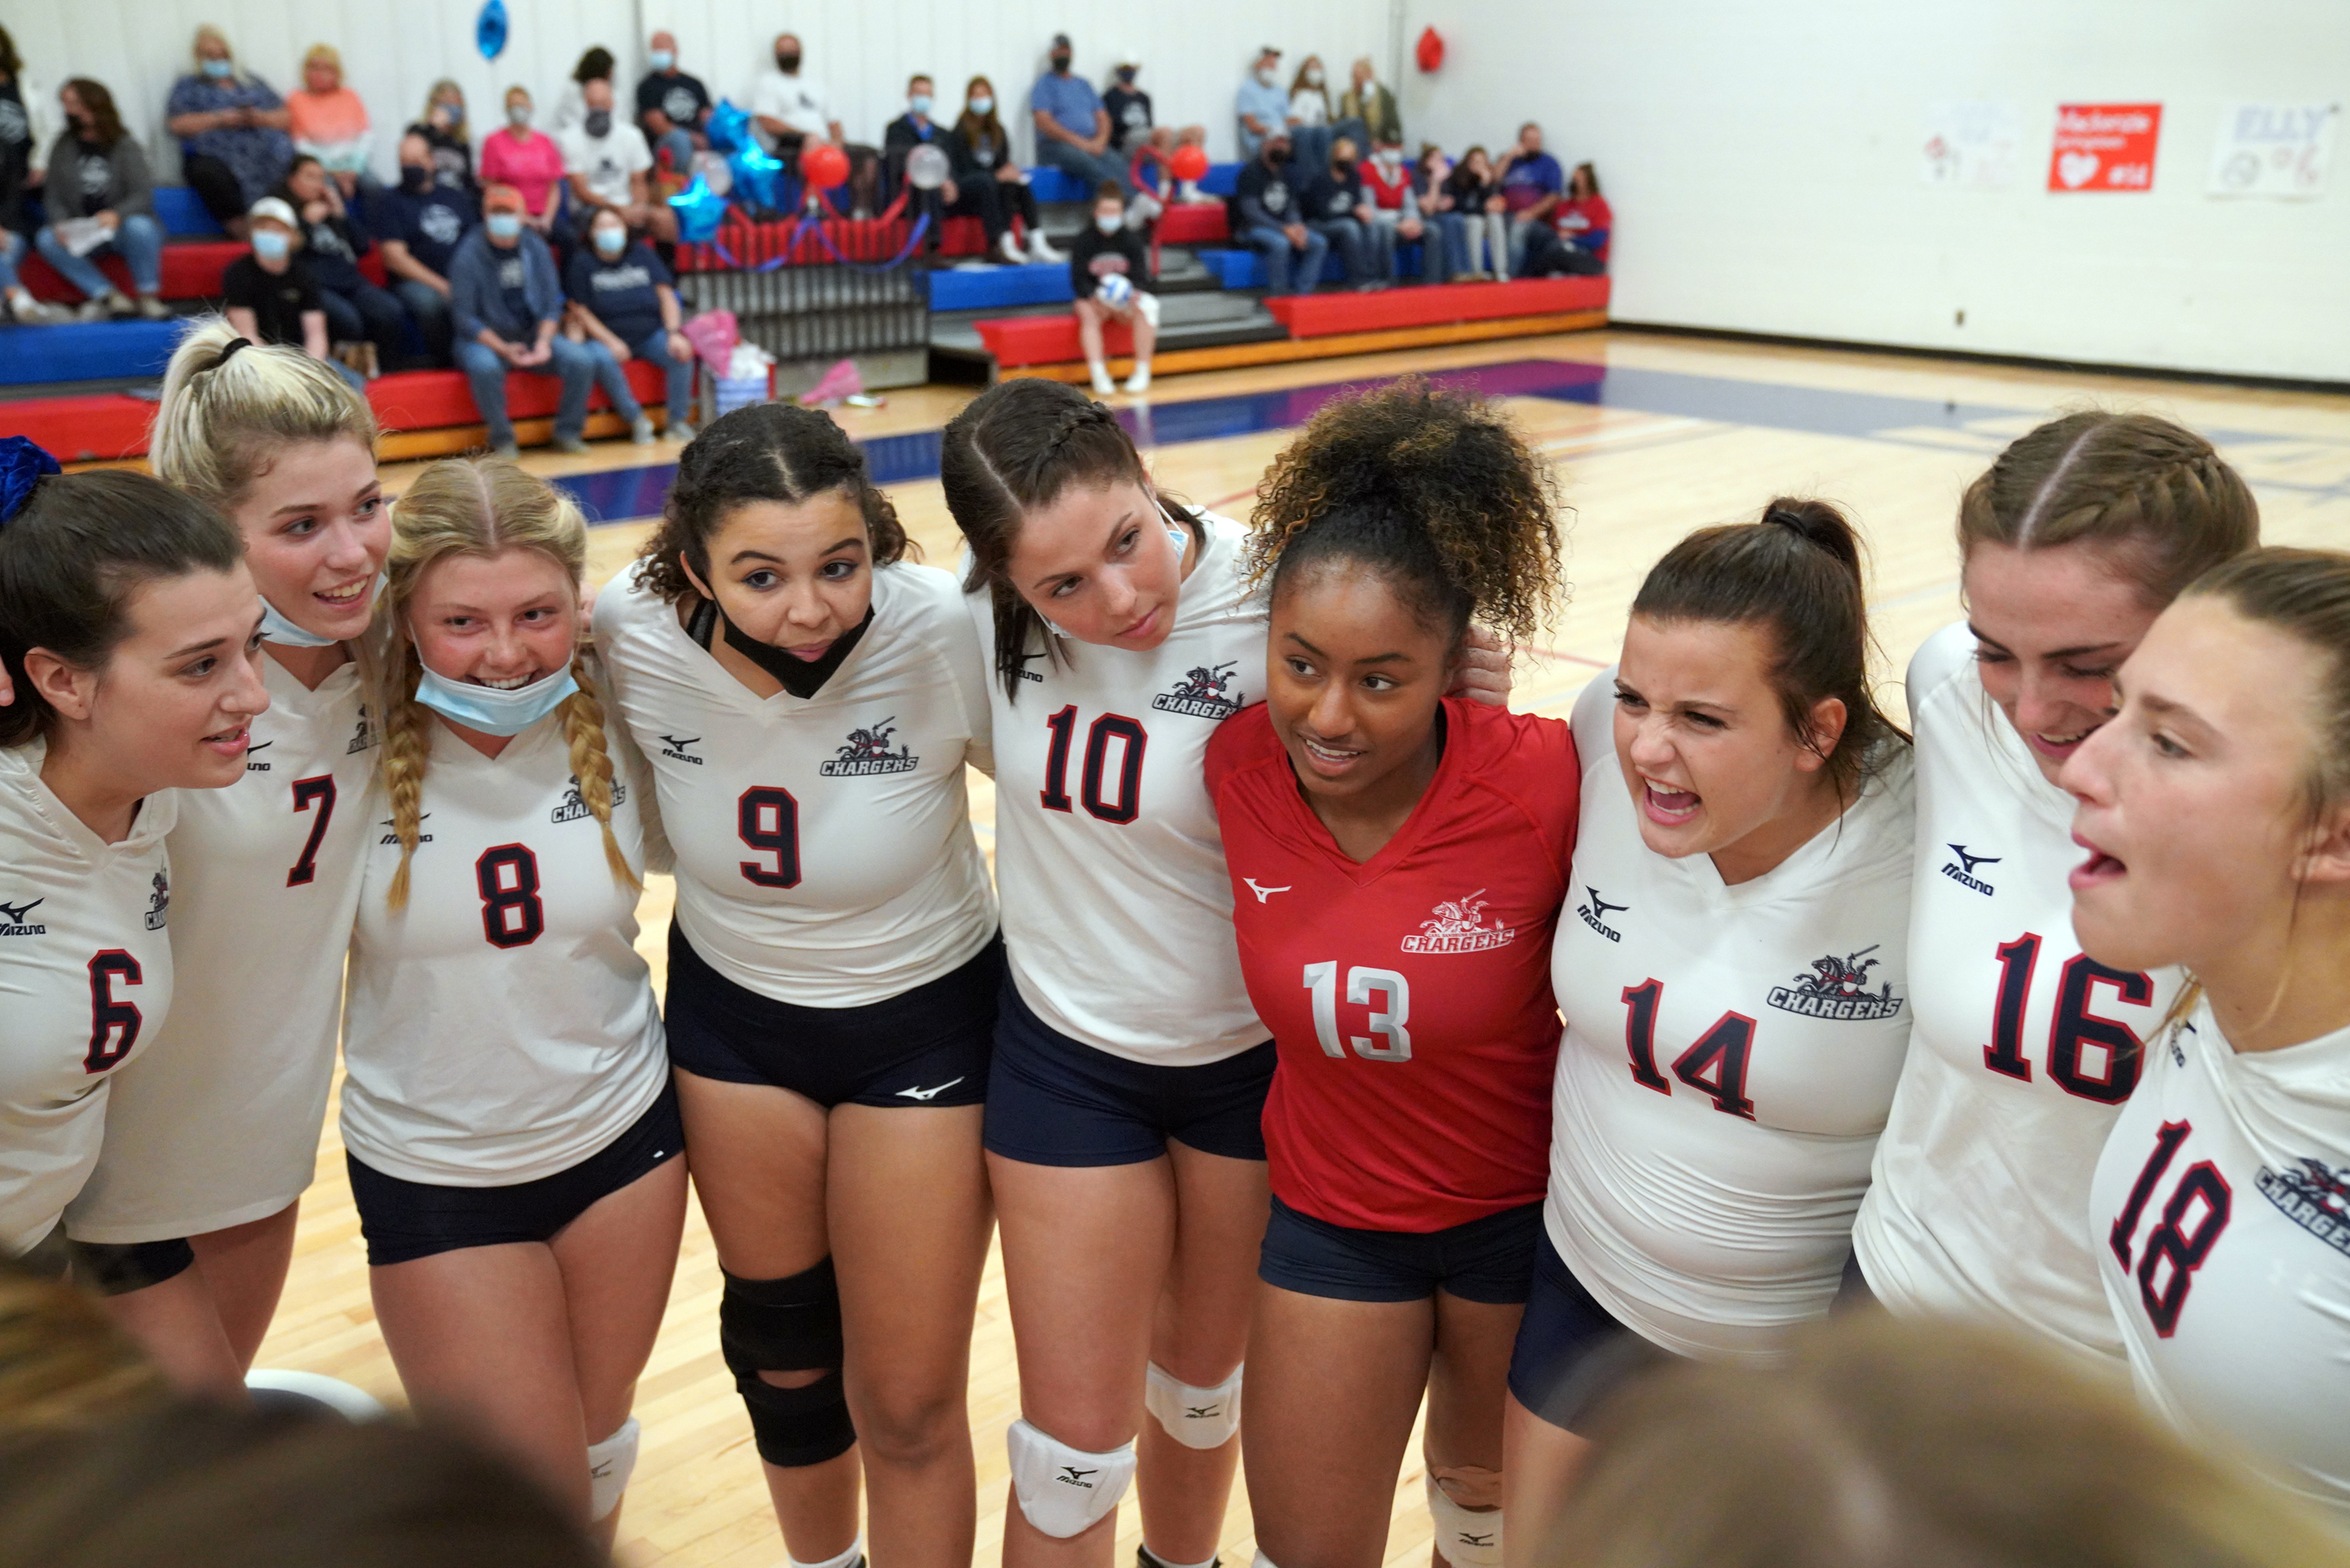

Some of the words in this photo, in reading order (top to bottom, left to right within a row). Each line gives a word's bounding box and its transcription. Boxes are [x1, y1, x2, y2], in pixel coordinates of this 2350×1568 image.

[662, 748, 703, 765] MIZUNO
[820, 757, 918, 776] CHARGERS
[1040, 704, 1148, 825] 10
[286, 774, 337, 888] 7
[738, 785, 802, 889] 9
[1941, 862, 1994, 896] MIZUNO
[475, 842, 545, 949] 8
[1402, 930, 1514, 952] CHARGERS
[1577, 904, 1621, 942] MIZUNO
[83, 949, 143, 1074] 6
[1303, 960, 1412, 1062] 13
[1621, 977, 1757, 1121] 14
[1768, 987, 1901, 1019] CHARGERS
[1983, 932, 2154, 1105] 16
[2110, 1118, 2232, 1338] 18
